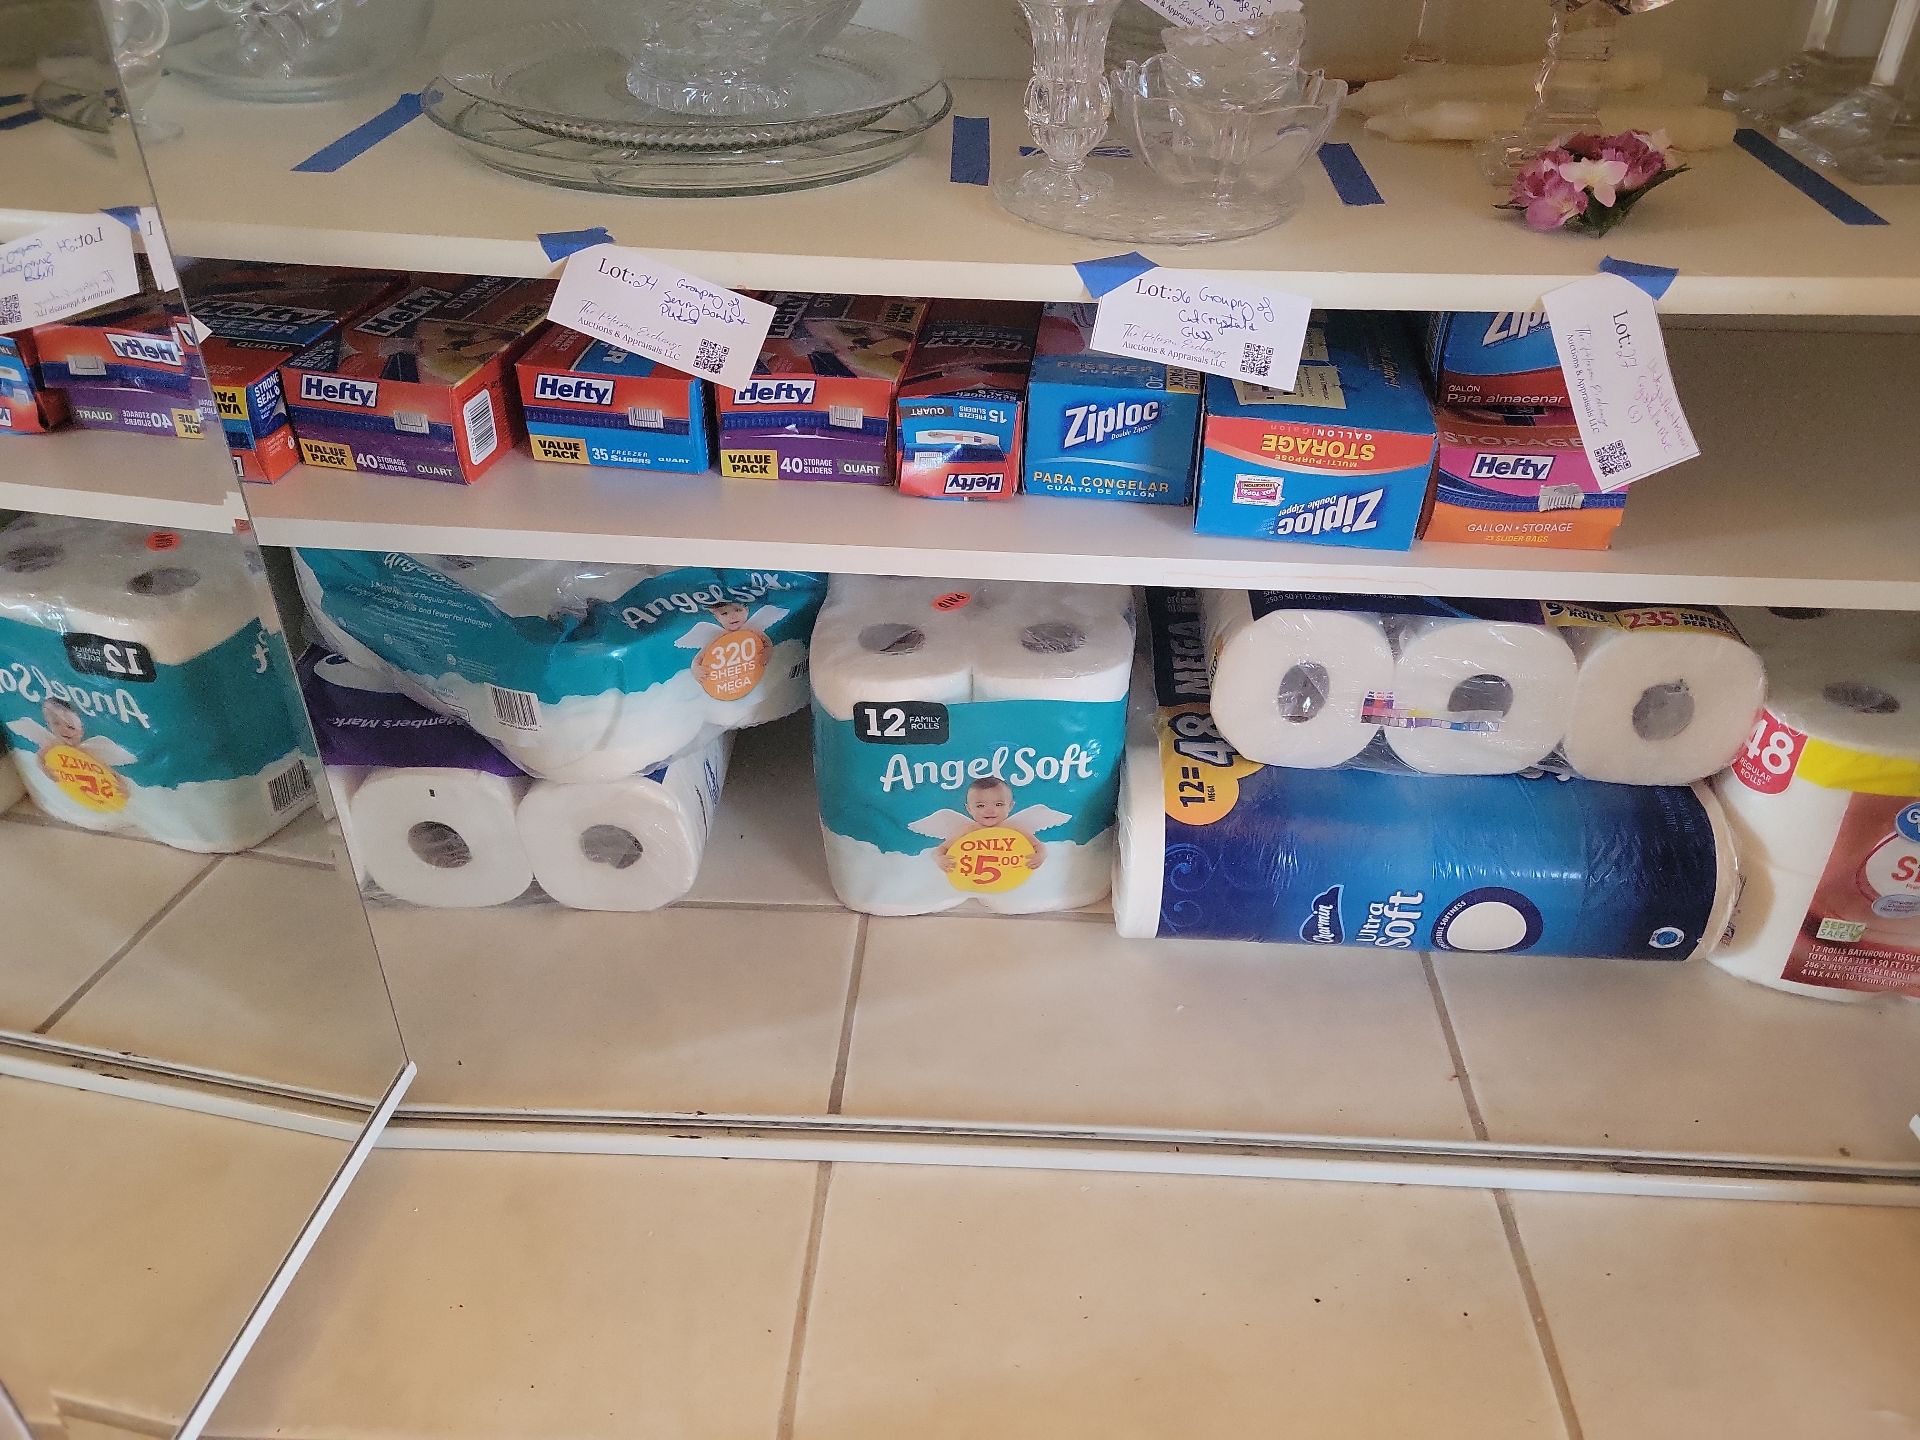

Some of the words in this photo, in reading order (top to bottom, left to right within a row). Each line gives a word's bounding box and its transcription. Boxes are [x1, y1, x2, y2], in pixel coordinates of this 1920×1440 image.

[577, 317, 613, 336] Auctions
[614, 331, 621, 339] &
[623, 333, 663, 355] Appraisals
[664, 350, 681, 361] LLC
[1122, 340, 1157, 354] Auctions
[1159, 347, 1166, 355] &
[1167, 348, 1209, 365] Appraisals
[1210, 358, 1227, 369] LLC
[305, 376, 374, 406] Hefty
[539, 377, 609, 404] Hefty
[1449, 384, 1481, 393] GALÓN
[1567, 334, 1579, 370] Auctions
[1577, 378, 1592, 419] Appraisals
[1589, 419, 1600, 433] LLC
[257, 390, 275, 408] SEAL
[739, 382, 811, 402] Hefty
[1447, 393, 1482, 404] Para
[1486, 393, 1565, 404] almacenar
[910, 407, 945, 416] QUART
[988, 410, 1008, 424] 15
[1064, 401, 1160, 448] Ziploc
[1111, 429, 1132, 440] Double
[1316, 429, 1373, 441] GALLON
[304, 443, 347, 458] VALUE
[538, 440, 581, 451] VALUE
[1261, 434, 1376, 461] STORAGE
[311, 453, 347, 466] PACK
[544, 450, 580, 460] PACK
[592, 447, 609, 461] 35
[611, 450, 649, 458] FREEZER
[611, 456, 651, 465] SLIDERS
[728, 455, 772, 465] VALUE
[1274, 454, 1358, 468] MULTI-PURPOSE
[356, 453, 378, 468] 40
[377, 456, 406, 466] STORAGE
[417, 464, 453, 477] QUART
[379, 464, 408, 474] SLIDERS
[733, 464, 769, 474] PACK
[780, 458, 803, 474] 40
[804, 458, 833, 467] STORAGE
[843, 463, 881, 475] QUART
[804, 466, 833, 475] SLIDERS
[1475, 456, 1550, 480] Hefty
[948, 475, 1001, 491] Hefty
[1033, 472, 1074, 485] PARA
[1081, 476, 1169, 493] CONGELAR
[1046, 484, 1092, 494] CUARTO
[1117, 488, 1156, 498] GALÓN
[1308, 495, 1337, 509] Double
[1277, 488, 1384, 535] Ziploc
[1278, 503, 1306, 518] Zipper
[1467, 523, 1513, 533] GALLON
[1521, 523, 1574, 533] STORAGE
[621, 583, 729, 630] Angel
[432, 609, 452, 619] fewer
[464, 616, 493, 629] changes
[1624, 612, 1681, 630] 235
[711, 638, 757, 670] 320
[709, 660, 756, 681] SHEETS
[716, 679, 752, 694] MEGA
[864, 708, 906, 737] 12
[909, 716, 942, 725] FAMILY
[911, 723, 941, 731] ROLLS
[879, 746, 1009, 793] Angel
[1009, 743, 1094, 787] Soft
[1740, 757, 1772, 782] REGULAR
[1207, 785, 1216, 802] MEGA
[960, 838, 1016, 852] ONLY
[1374, 890, 1424, 948] Soft
[1440, 900, 1467, 926] SOFTNESS
[1312, 904, 1335, 943] Charmin
[1355, 902, 1384, 943] Ultra
[1823, 919, 1864, 931] SEPTIC
[1820, 928, 1847, 939] SAFE
[1811, 944, 1821, 952] 12
[1822, 946, 1847, 955] ROLLS
[1847, 948, 1892, 959] BATHROOM
[1808, 952, 1830, 961] TOTAL
[1832, 955, 1853, 964] AREA
[1877, 959, 1889, 967] SQ
[1890, 960, 1901, 968] FT
[1844, 965, 1874, 974] SHEETS
[1873, 967, 1889, 976] PER
